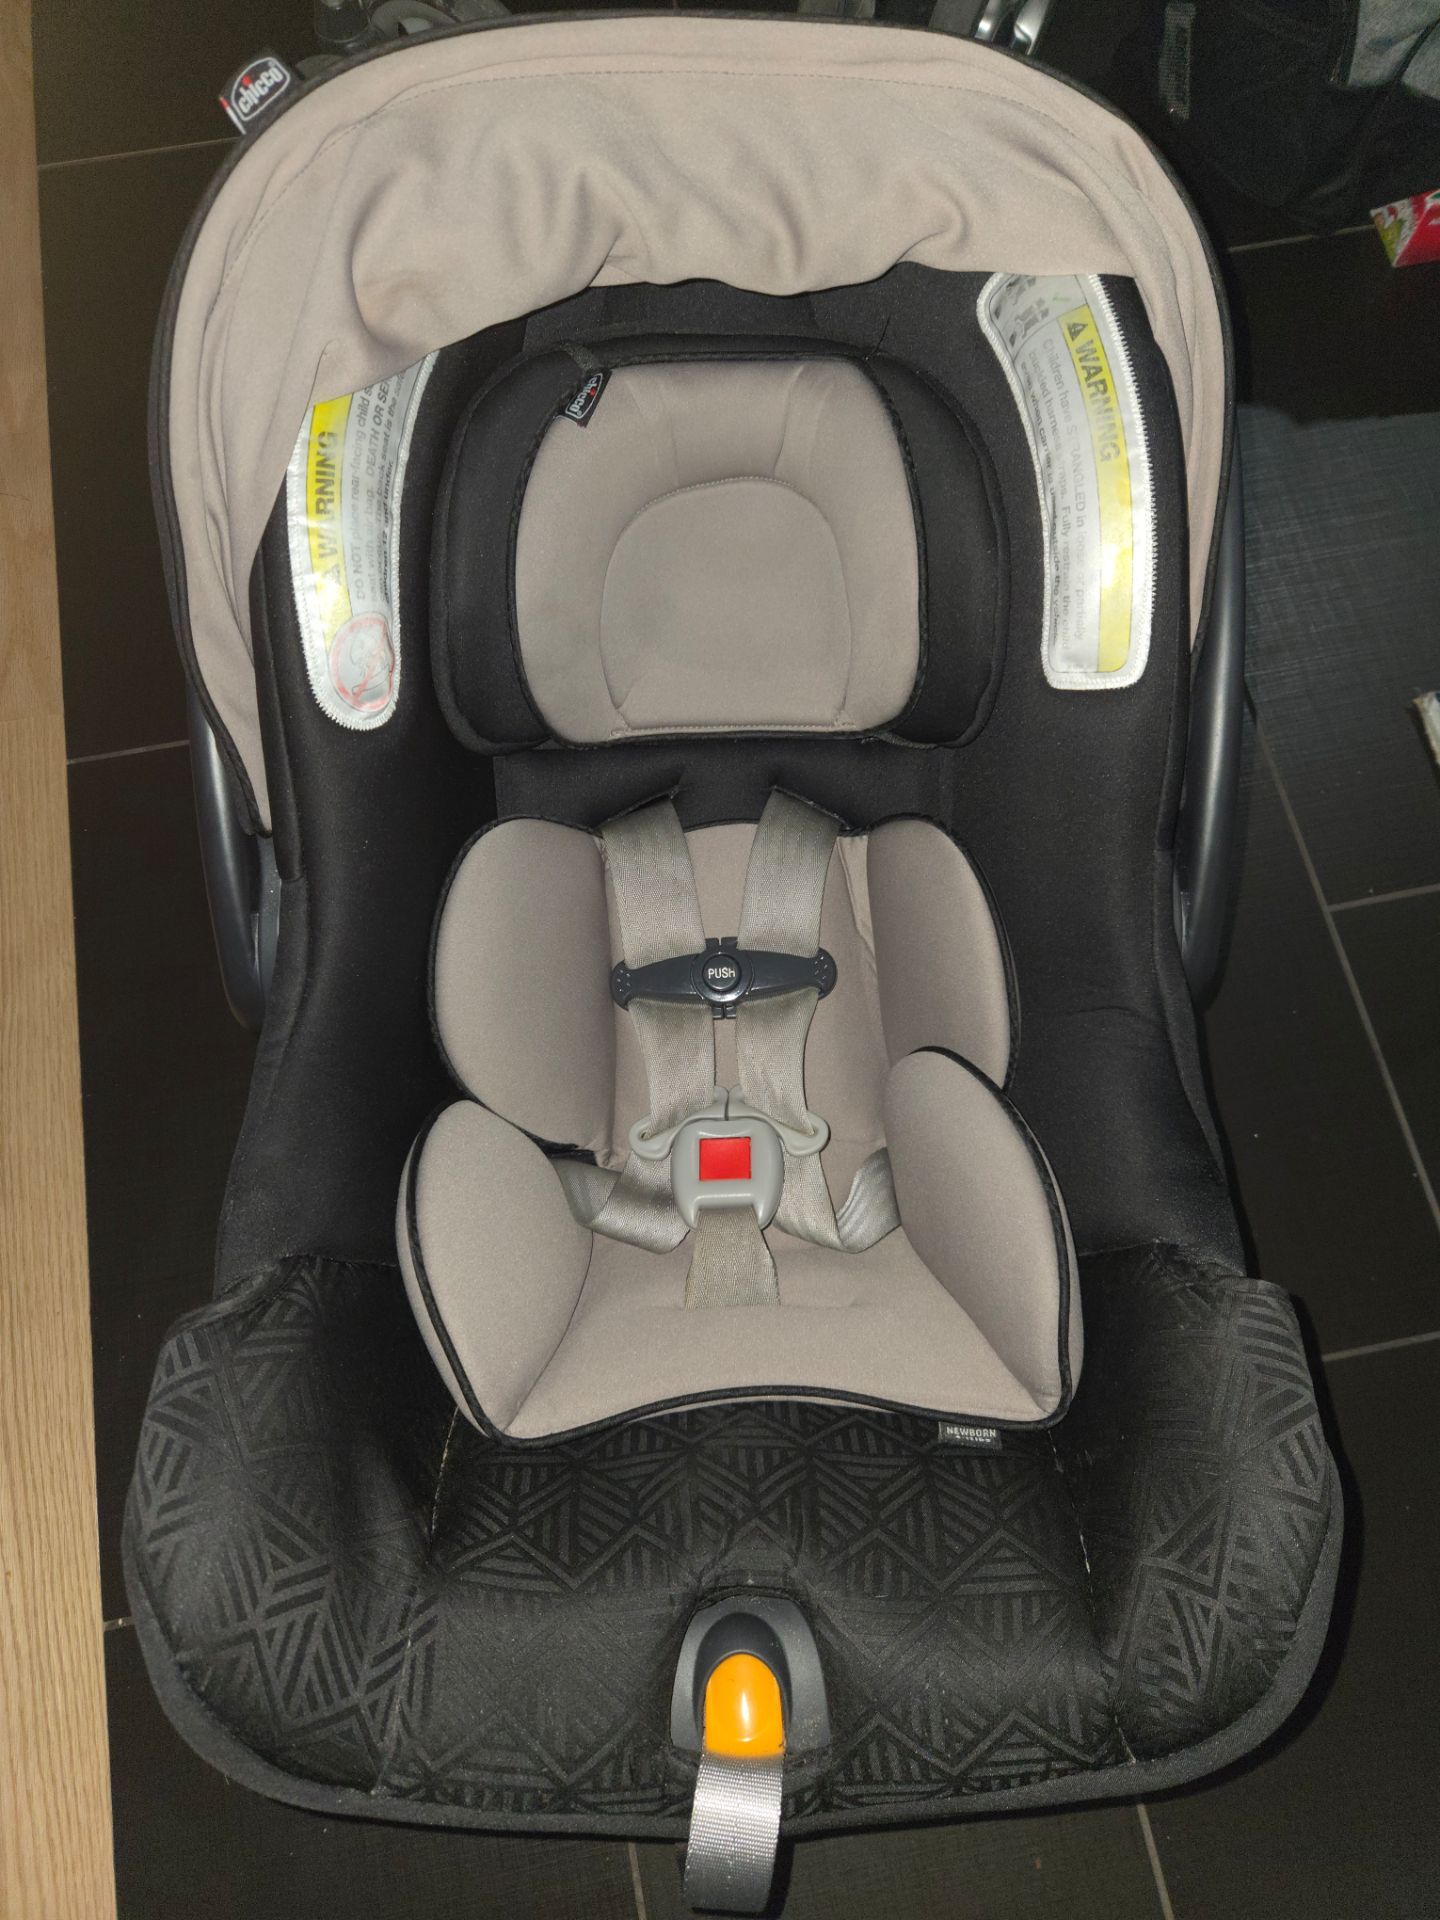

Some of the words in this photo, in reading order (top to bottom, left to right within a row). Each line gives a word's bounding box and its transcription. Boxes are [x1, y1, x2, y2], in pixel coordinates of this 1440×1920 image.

[238, 66, 284, 114] chicco
[1029, 349, 1051, 398] buckled
[1043, 338, 1064, 390] Children
[386, 397, 397, 418] the
[569, 377, 598, 413] chicco
[1030, 393, 1045, 425] when
[1058, 390, 1072, 423] have
[1075, 340, 1121, 462] WARNING
[356, 396, 370, 427] child
[373, 405, 385, 426] OR
[384, 419, 392, 431] is
[1045, 398, 1063, 450] harness
[365, 429, 380, 476] DEATH
[381, 433, 391, 461] seat
[350, 504, 361, 540] place
[1061, 506, 1070, 537] Fully
[1077, 515, 1086, 527] in
[350, 544, 362, 574] NOT
[365, 540, 375, 568] with
[1062, 541, 1071, 592] restrain
[354, 578, 365, 600] DO
[1063, 595, 1072, 617] the
[1074, 589, 1087, 640] partially
[708, 967, 736, 979] PUSH
[946, 1426, 997, 1437] NEWBORN
